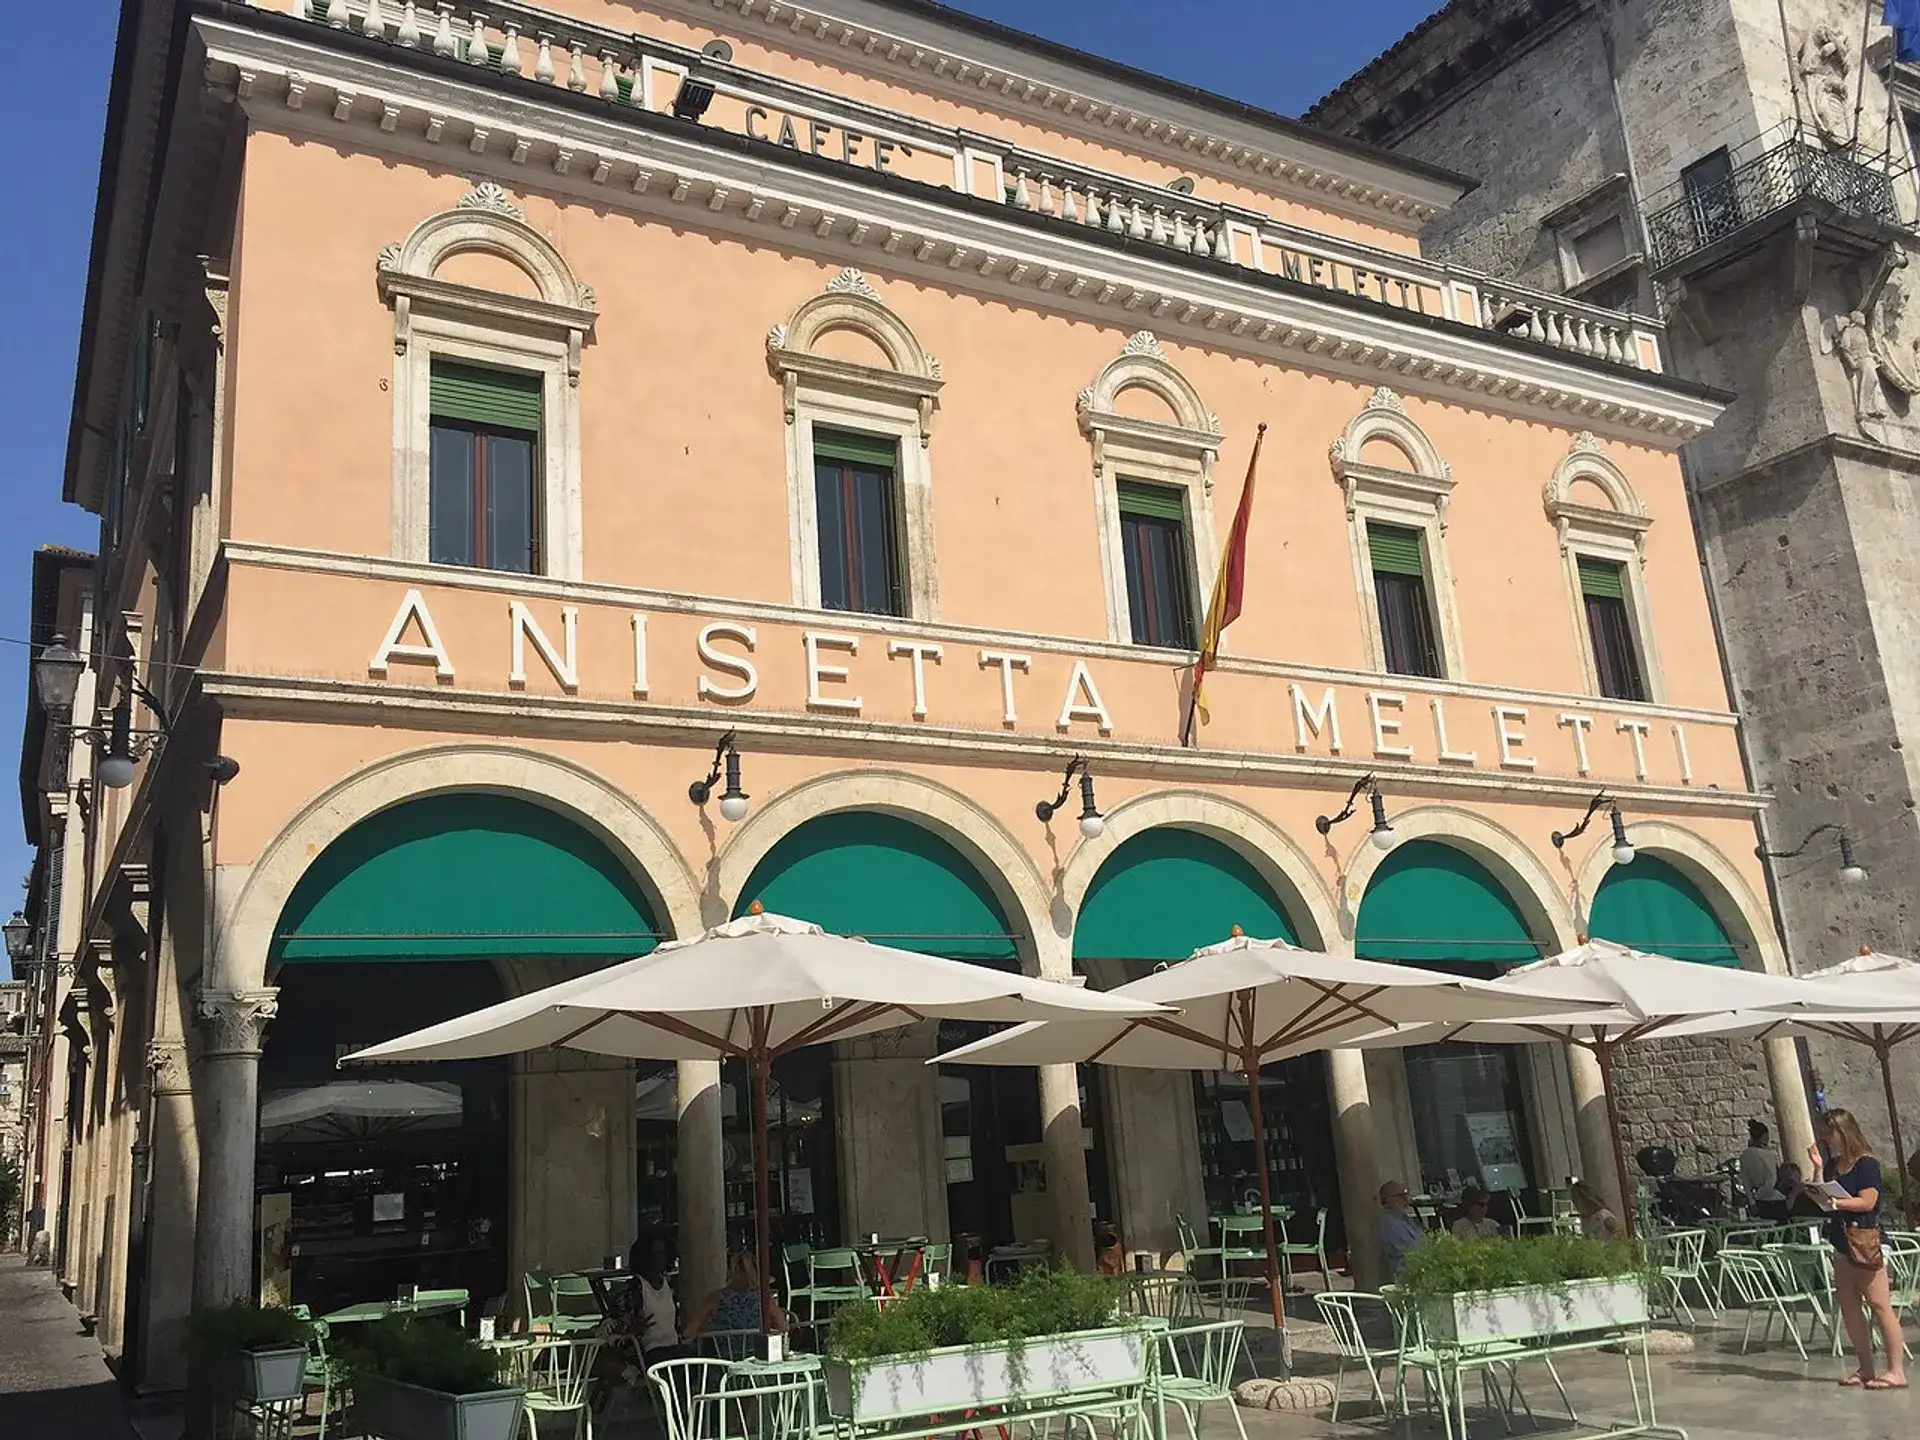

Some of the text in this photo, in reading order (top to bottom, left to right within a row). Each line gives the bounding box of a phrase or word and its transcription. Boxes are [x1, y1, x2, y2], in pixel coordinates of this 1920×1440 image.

[1281, 250, 1425, 313] MELETTI
[369, 588, 1692, 785] ANISETTA MELETTI
